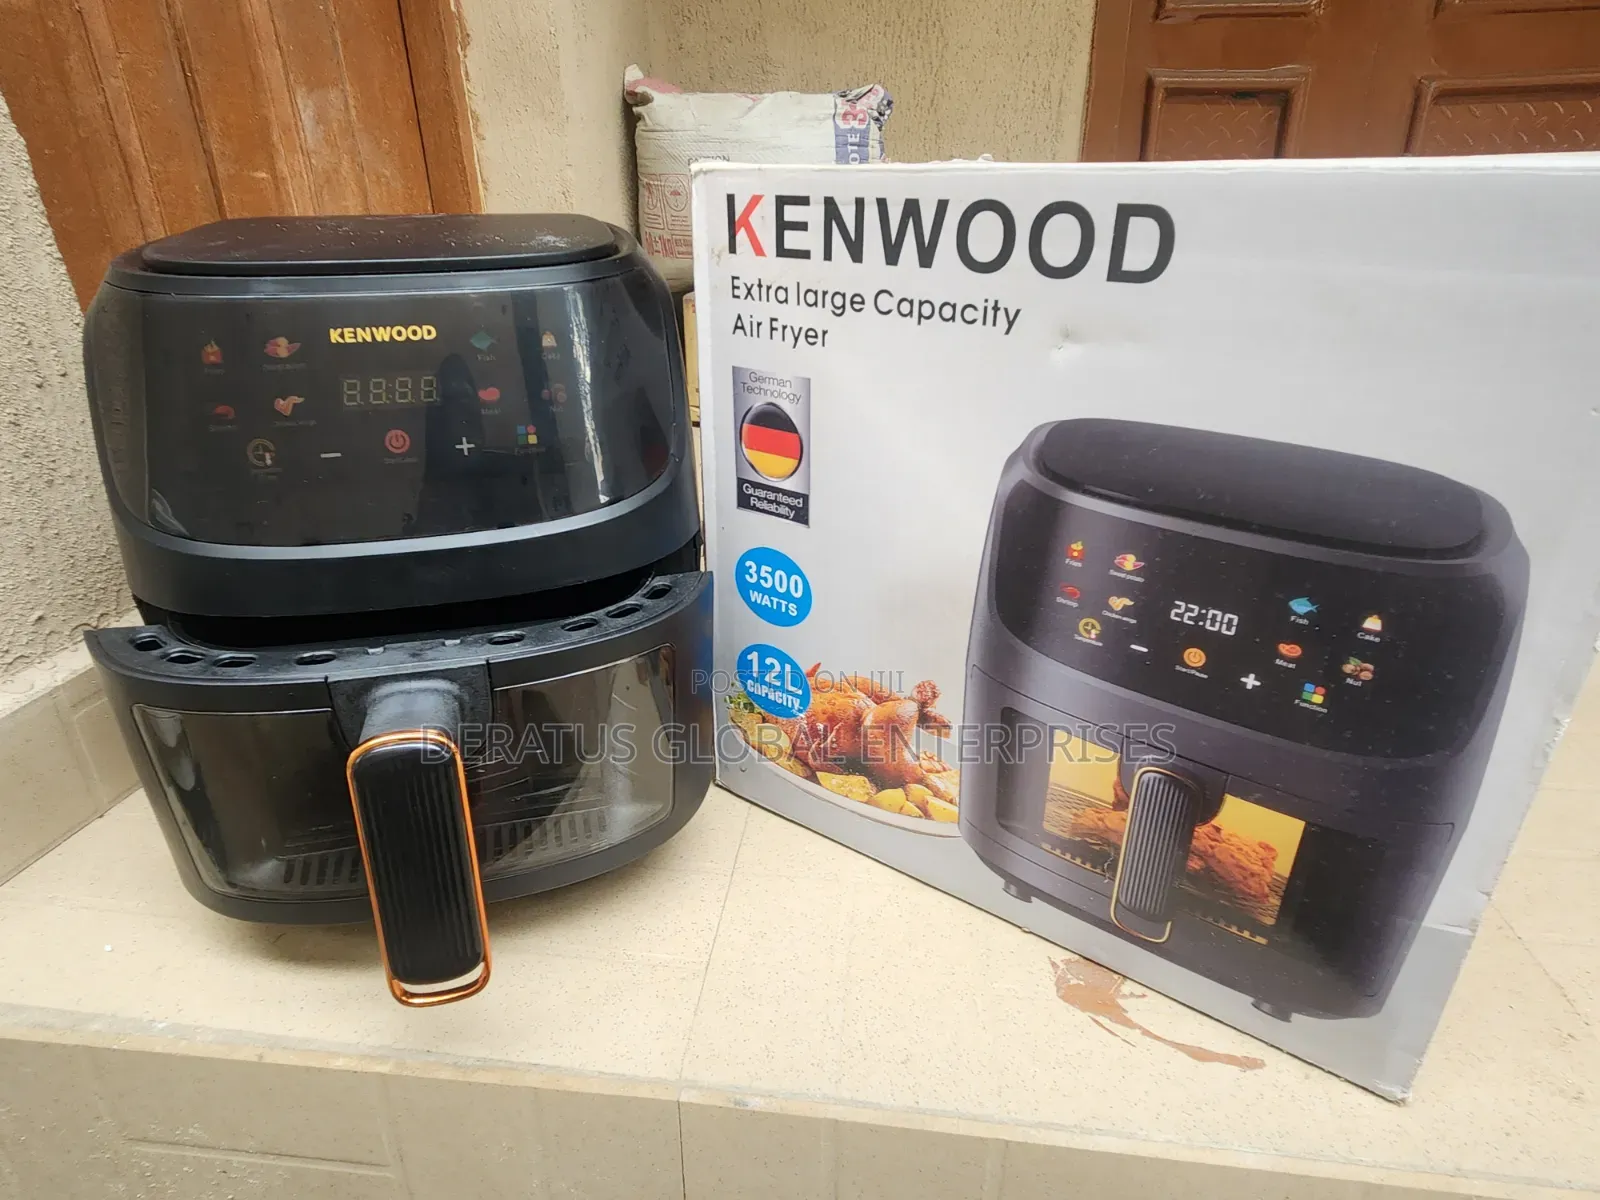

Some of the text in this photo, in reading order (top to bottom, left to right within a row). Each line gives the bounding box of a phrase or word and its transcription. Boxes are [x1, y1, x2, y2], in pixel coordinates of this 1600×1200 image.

[726, 193, 1176, 284] KENWOOD
[730, 275, 1022, 334] Extra large Capacity
[329, 325, 437, 343] KENWOOD
[732, 313, 829, 349] Air Fryer
[749, 371, 792, 389] German
[740, 381, 802, 405] Technology
[742, 483, 804, 508] Guaranteed
[750, 497, 795, 519] Reliability
[744, 560, 804, 598] 3500
[749, 589, 798, 617] WATTS
[1170, 600, 1239, 636] 22:00
[1290, 615, 1309, 625] Fish
[1357, 631, 1381, 643] Cake
[747, 651, 802, 695] 12L
[1293, 699, 1328, 714] Function
